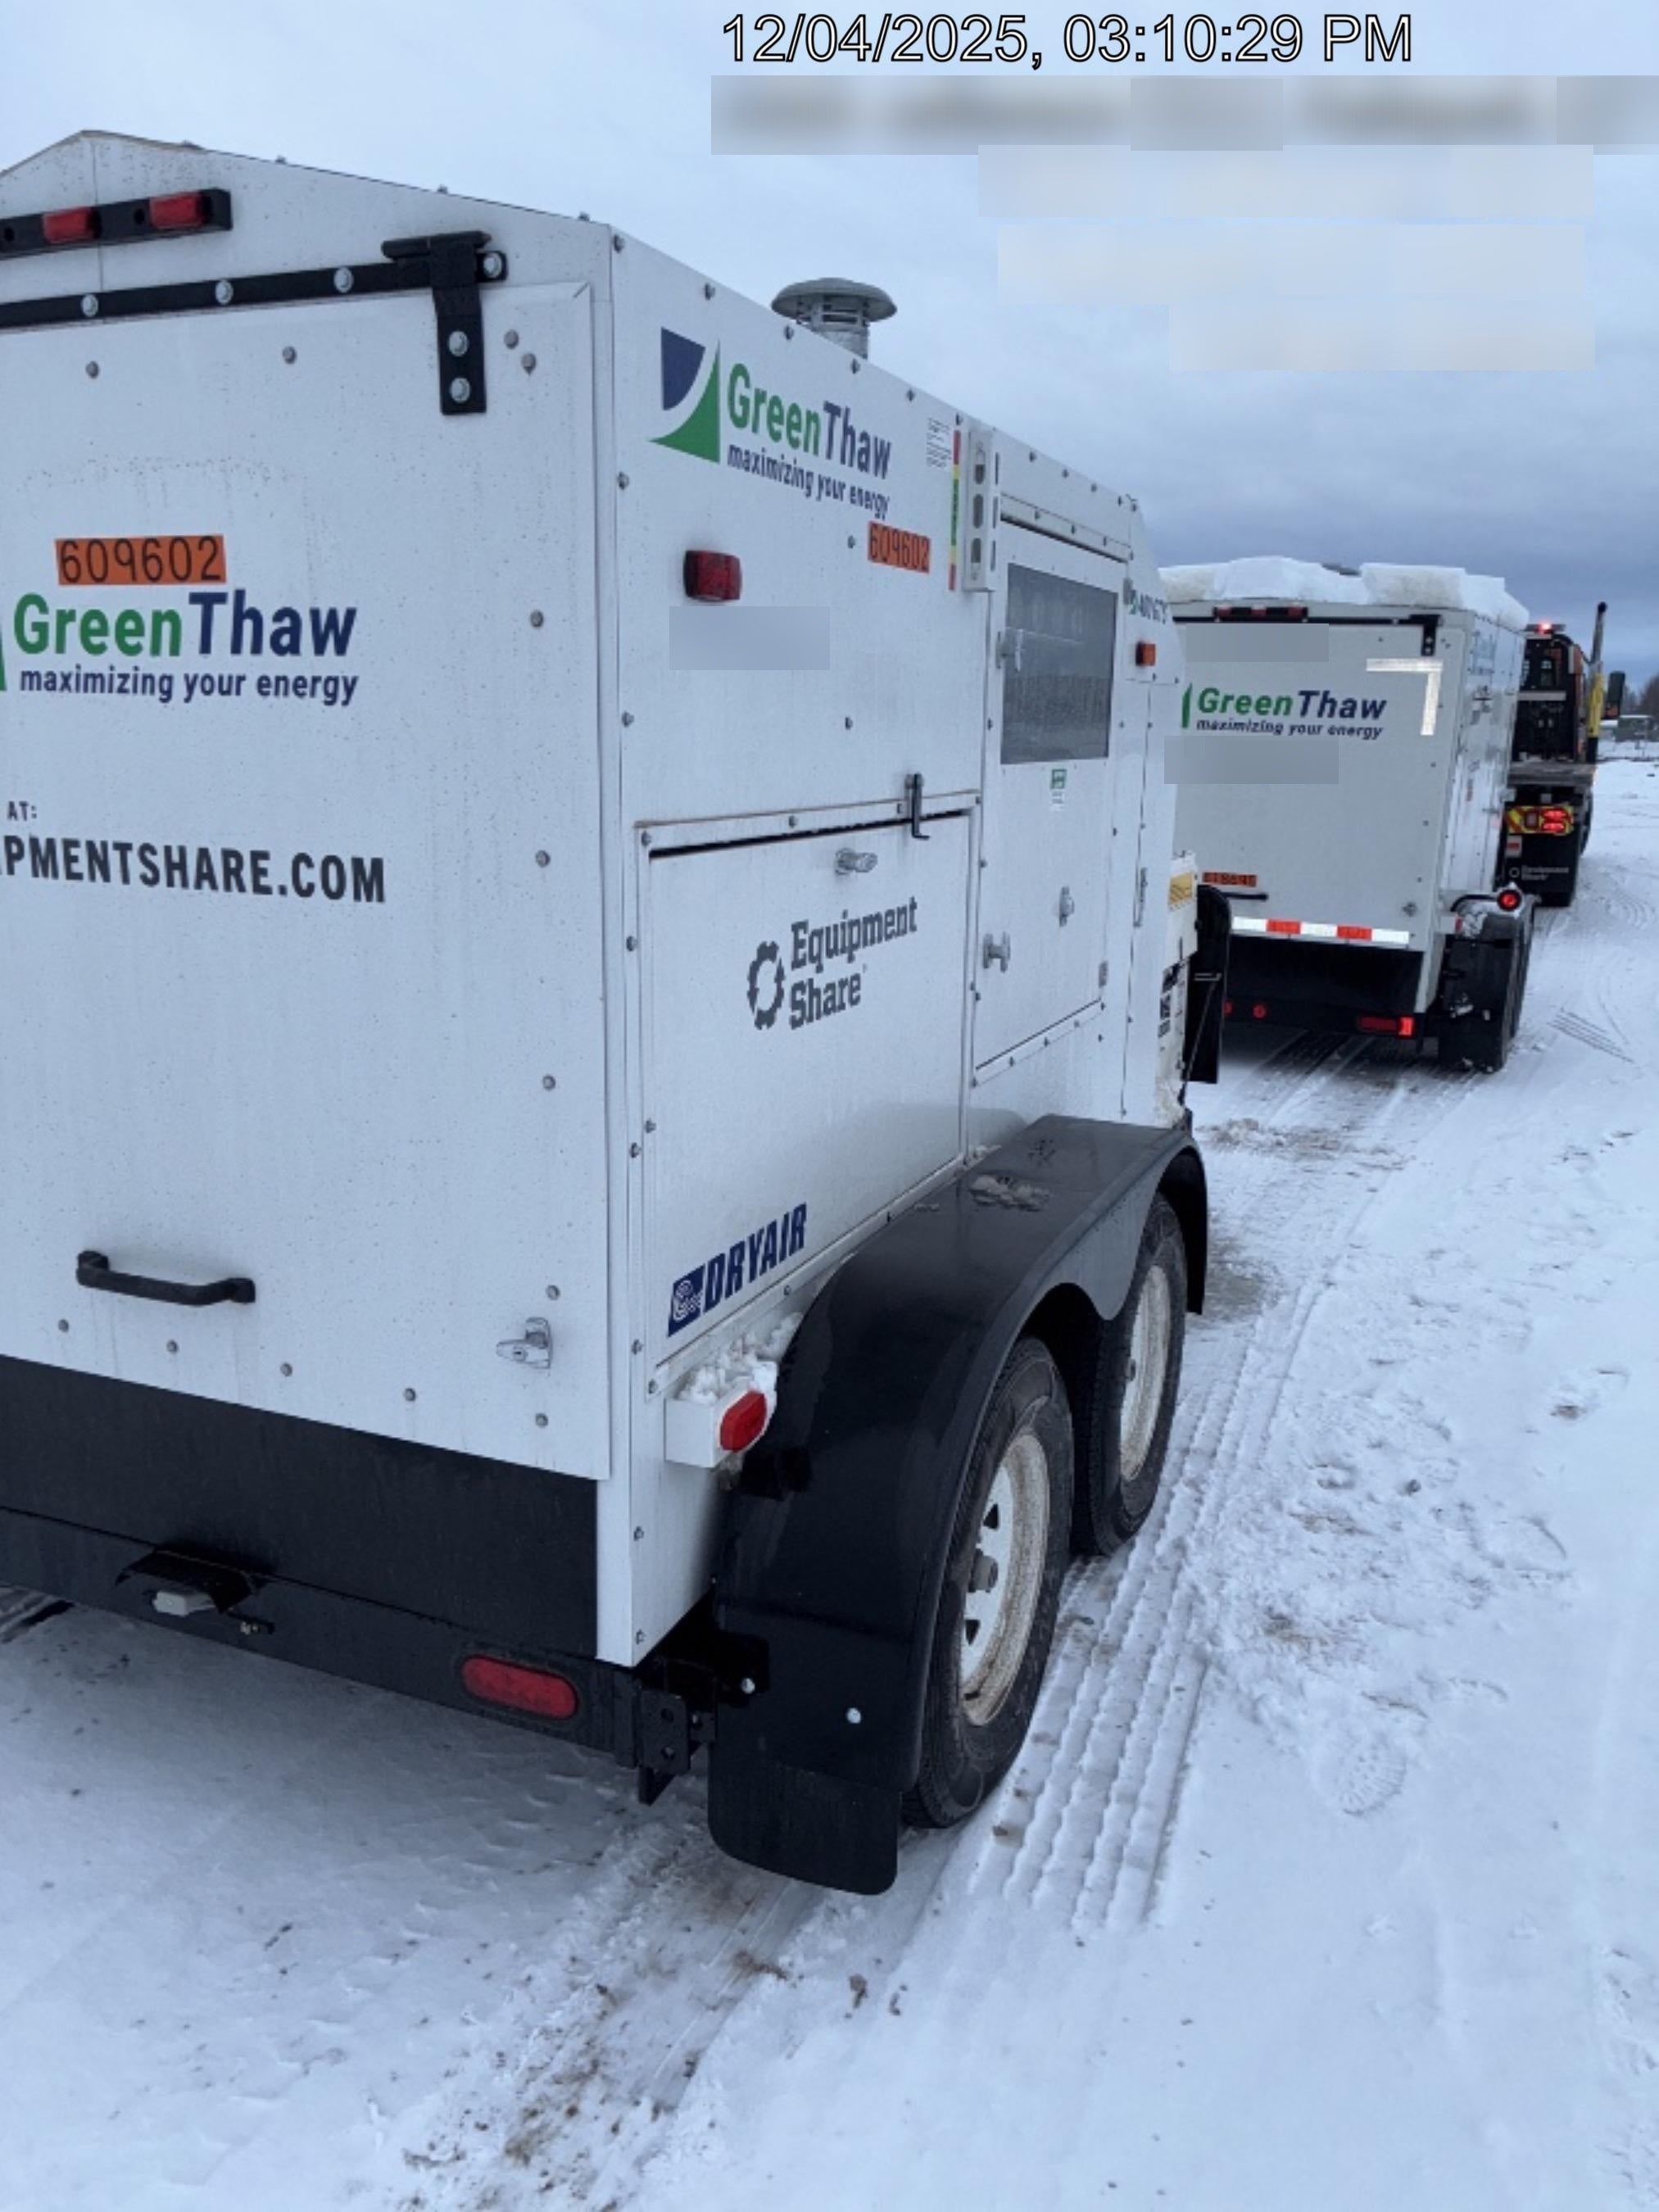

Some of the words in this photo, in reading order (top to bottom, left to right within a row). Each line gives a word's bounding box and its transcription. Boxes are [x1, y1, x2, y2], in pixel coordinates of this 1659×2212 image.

[728, 363, 892, 479] GreenThaw
[728, 443, 814, 499] maximizing
[817, 473, 846, 502] your
[849, 485, 891, 521] energy
[60, 536, 223, 582] 609602
[869, 522, 929, 573] 609602
[14, 589, 357, 657] GreenThaw
[20, 664, 173, 703] maximizing
[183, 673, 246, 703] your
[256, 674, 359, 706] energy
[1198, 687, 1387, 720] GreenThaw
[1196, 718, 1285, 737] maximizing
[1287, 723, 1324, 737] your
[1327, 724, 1385, 741] energy
[7, 801, 38, 820] AT:
[0, 834, 386, 903] PMENTSHARE.COM
[791, 895, 918, 972] Equipment
[789, 972, 861, 1030] Share
[703, 1201, 807, 1313] DRYAIR
